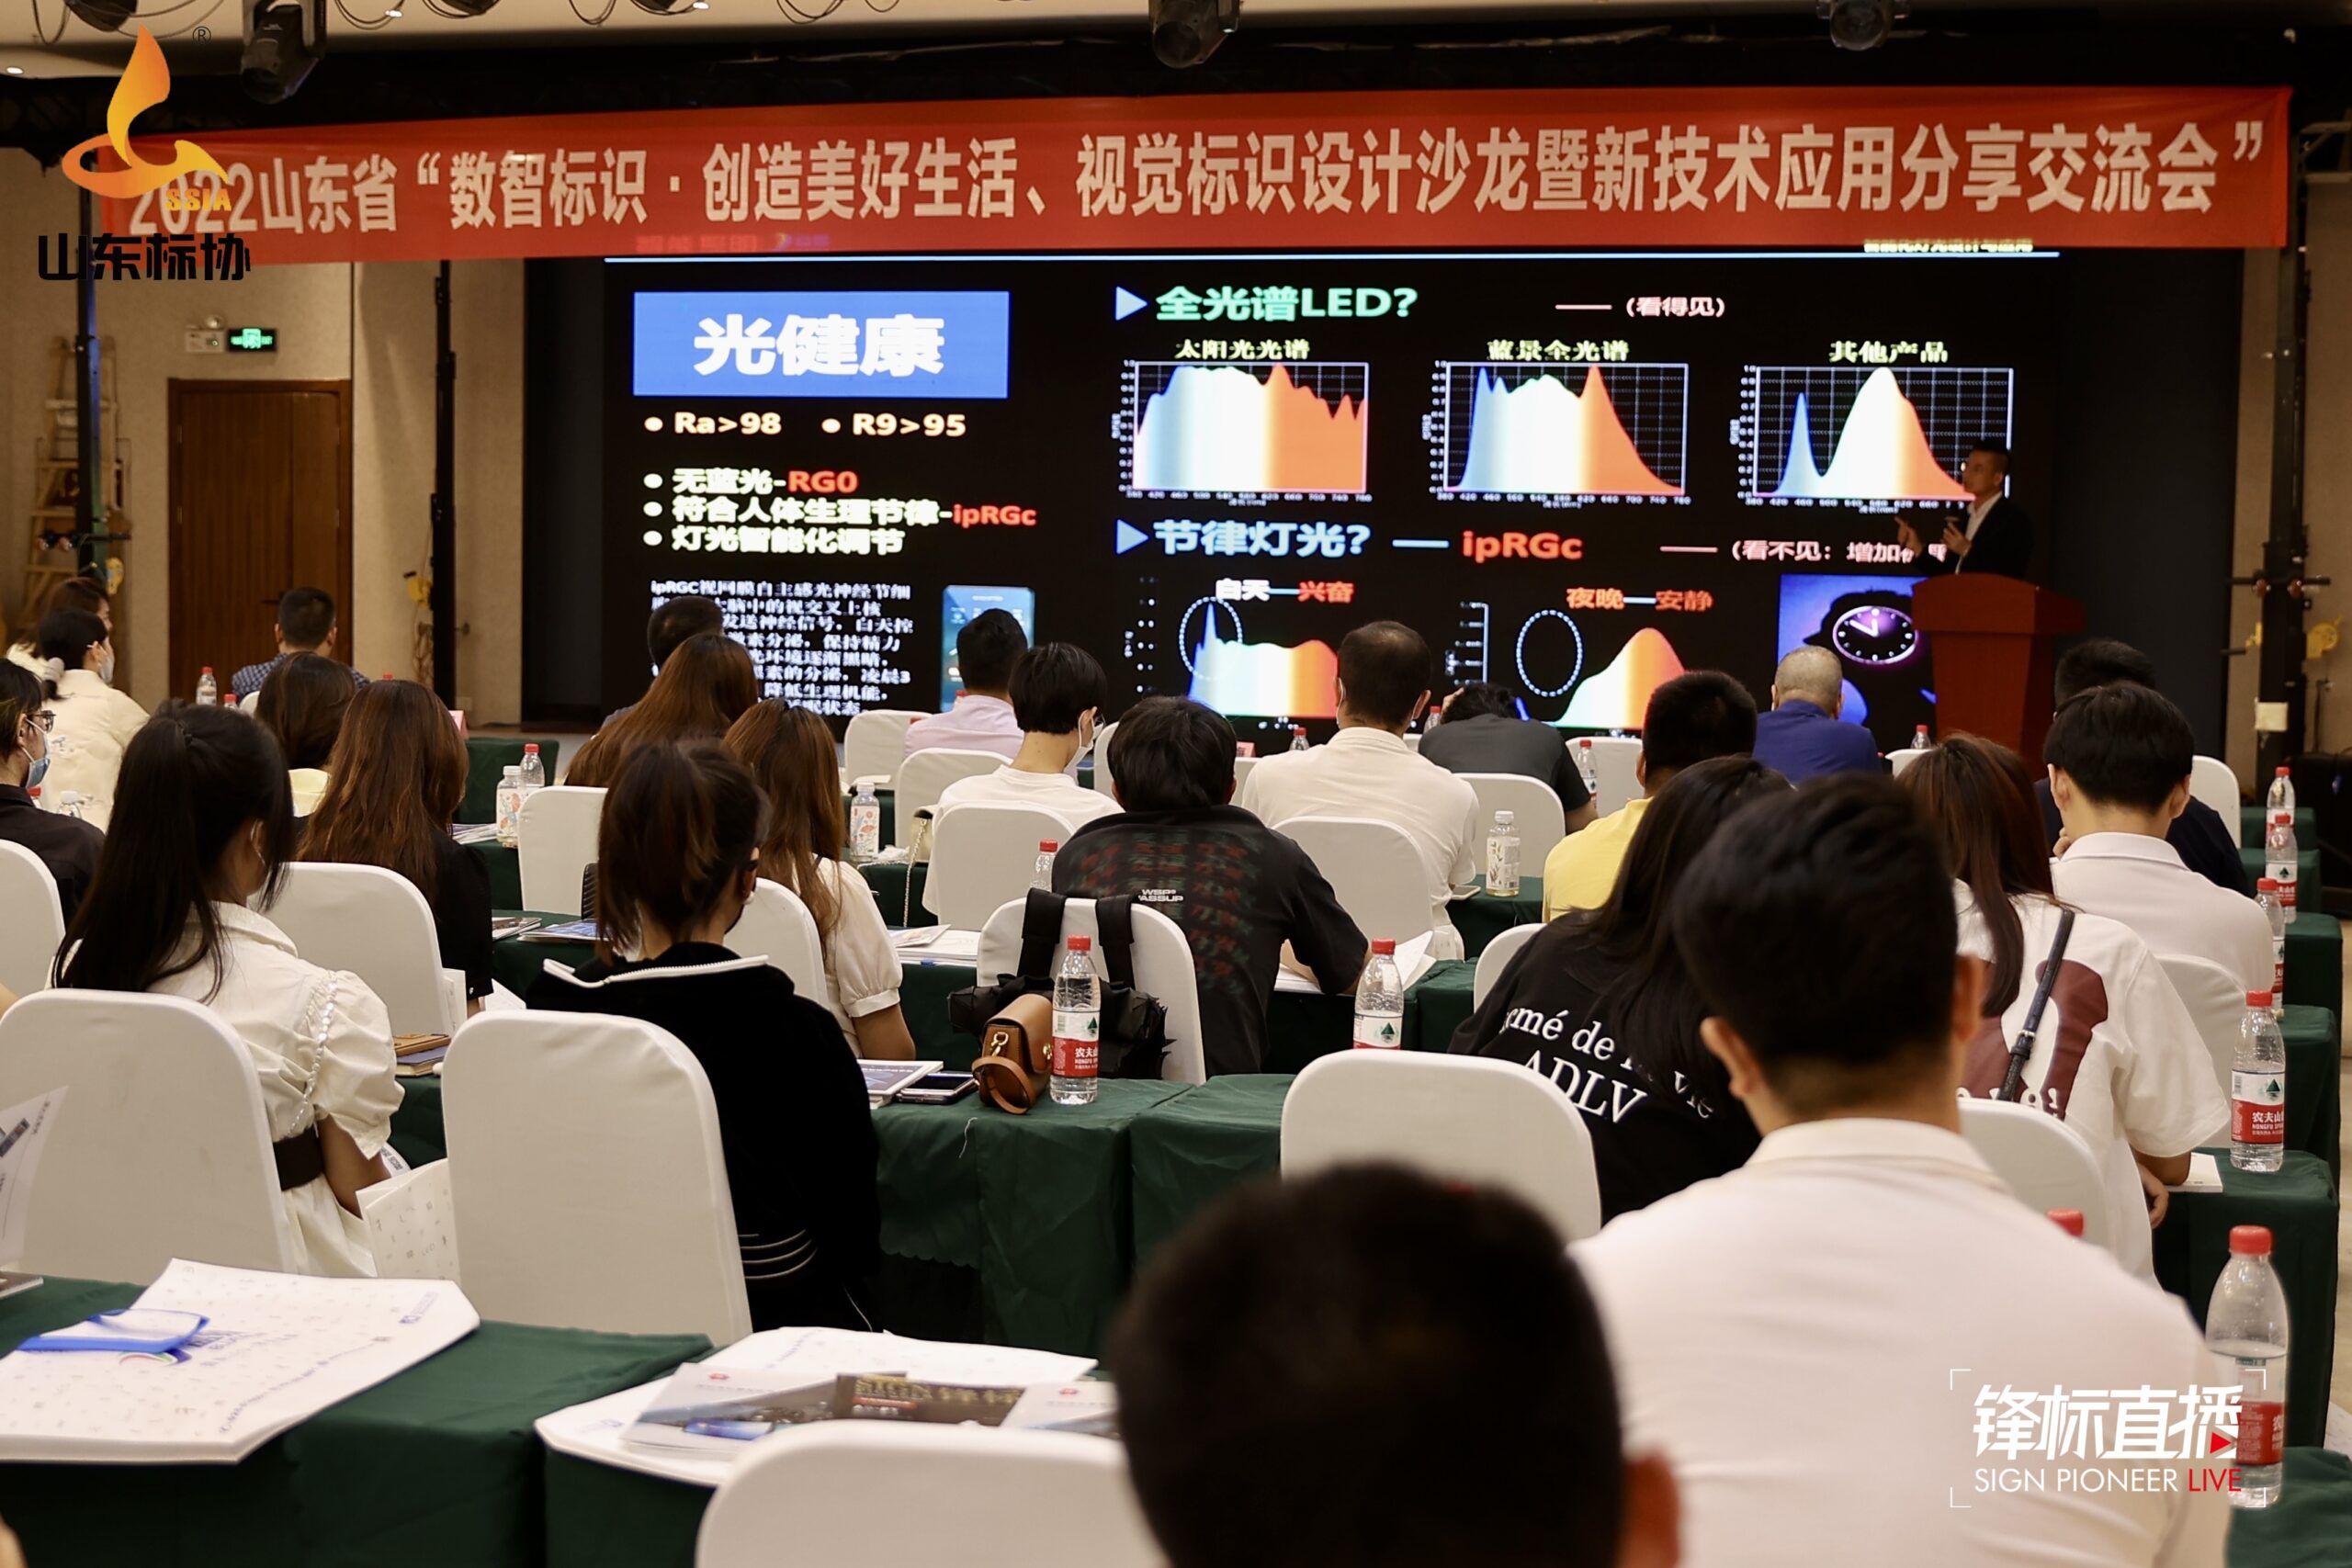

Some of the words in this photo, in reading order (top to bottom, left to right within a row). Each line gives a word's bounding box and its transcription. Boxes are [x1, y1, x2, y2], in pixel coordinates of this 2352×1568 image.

[1155, 287, 1418, 322] 全光谱LED?
[693, 313, 945, 377] 光健康
[1175, 339, 1311, 360] 太阳光光谱
[1829, 341, 1949, 363] 其他产品
[673, 412, 783, 434] Ra>98
[852, 413, 967, 436] R9>95
[672, 525, 906, 556] 灯光智能化调节
[1153, 519, 1372, 558] 节律灯光?
[1462, 530, 1584, 564] ipRGc
[1571, 1021, 1615, 1061] de
[1522, 1049, 1648, 1124] ADLV
[2252, 1111, 2284, 1123] 农夫山
